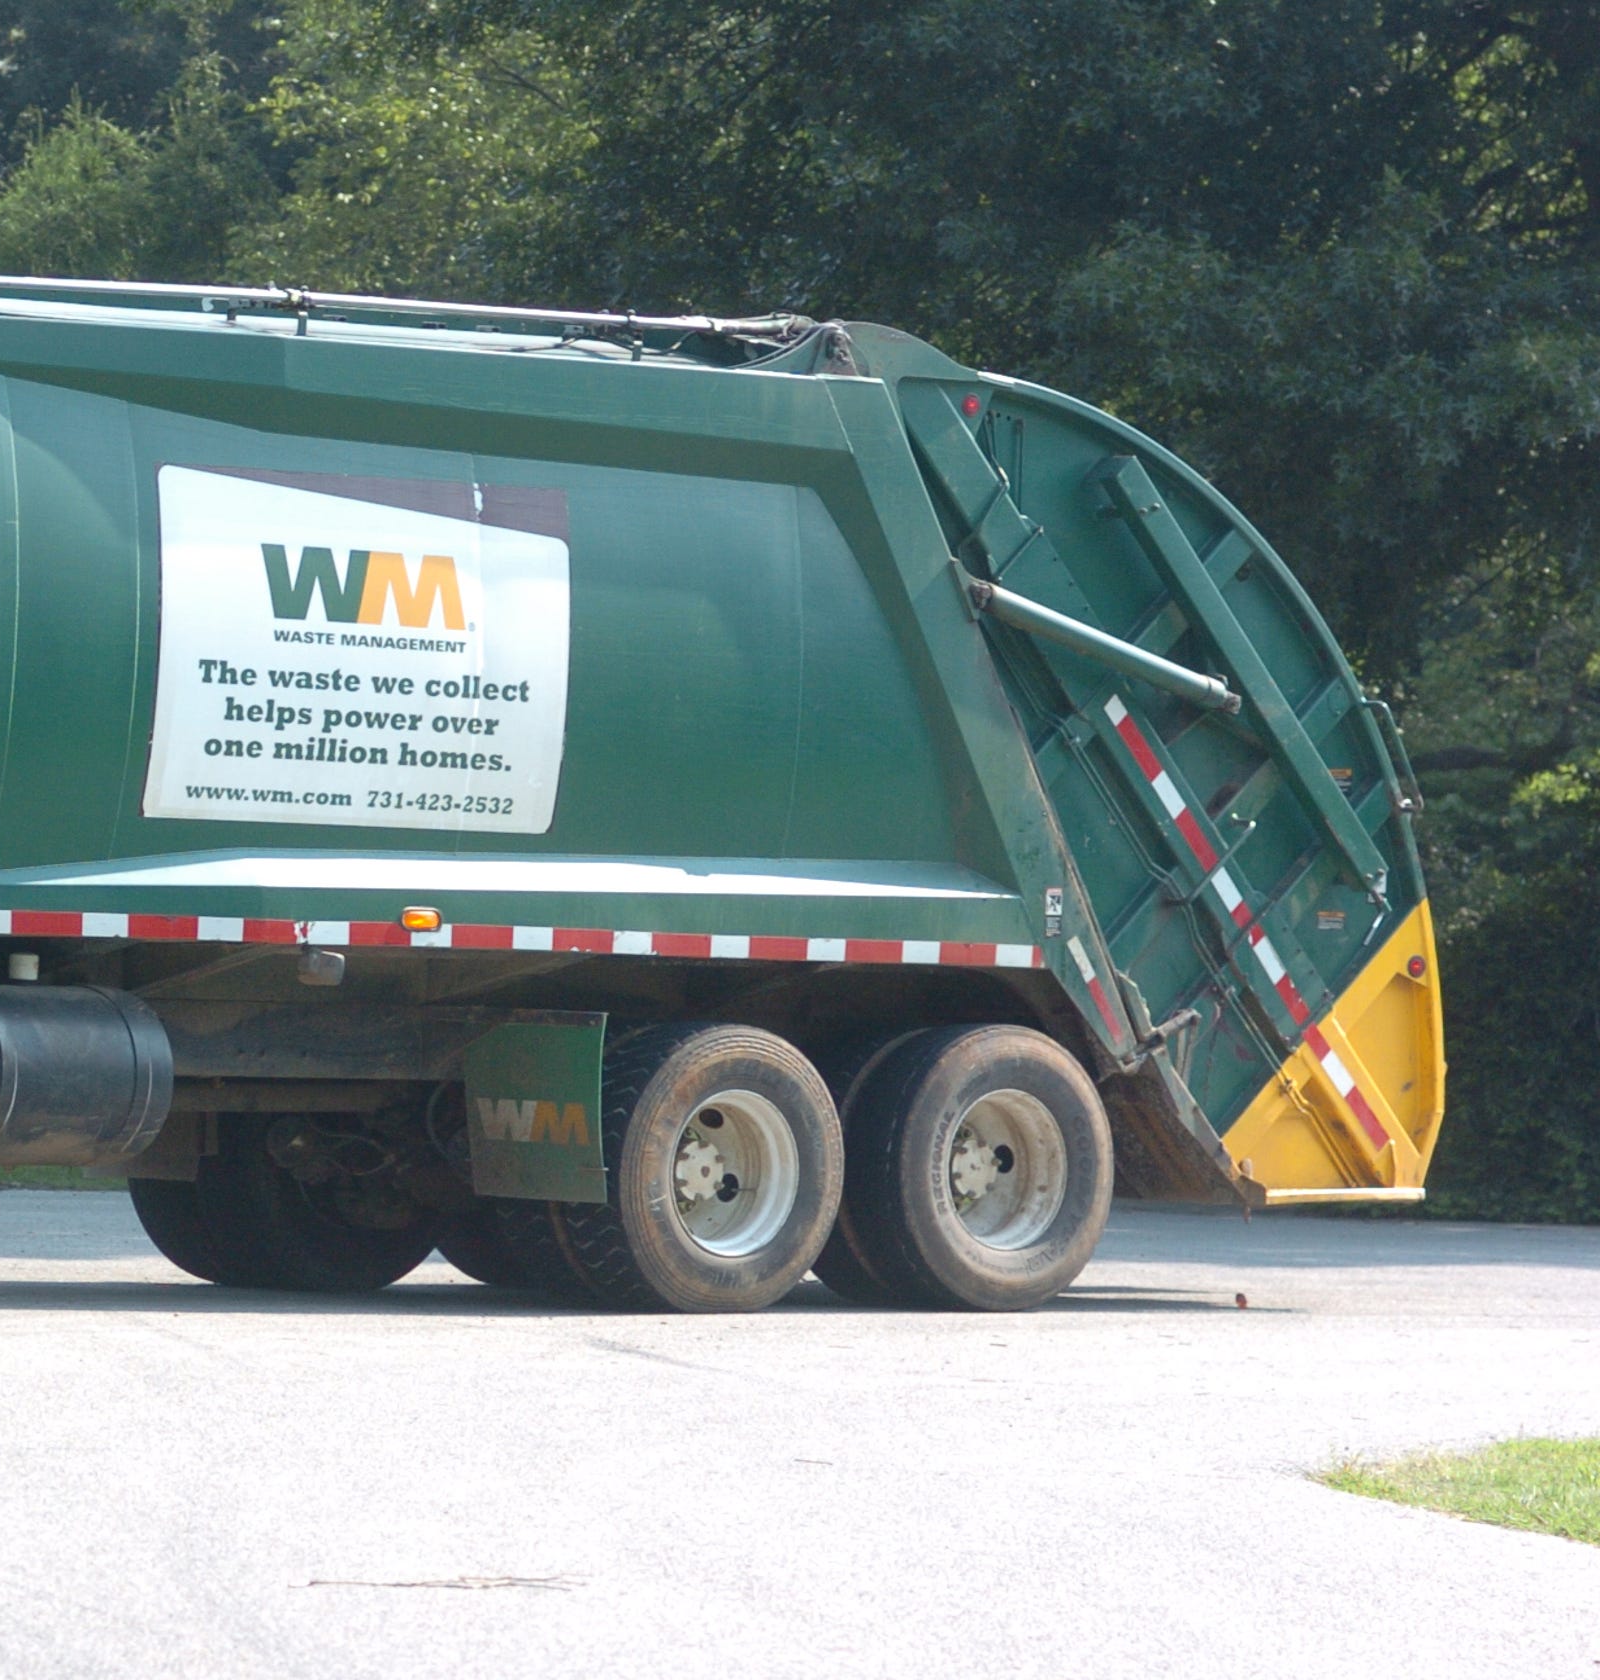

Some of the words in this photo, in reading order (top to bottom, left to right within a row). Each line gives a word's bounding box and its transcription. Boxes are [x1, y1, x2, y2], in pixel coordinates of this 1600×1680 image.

[261, 543, 467, 630] WM
[273, 630, 335, 647] WASTE
[341, 633, 467, 654] MANAGEMENT
[199, 658, 258, 686] The
[268, 668, 361, 693] waste
[371, 675, 414, 696] we
[424, 677, 530, 703] collect
[224, 697, 313, 727] helps
[322, 707, 423, 733] power
[432, 715, 500, 736] over
[204, 738, 263, 759] one
[273, 737, 390, 766] million
[398, 743, 513, 772] homes.
[185, 784, 353, 807] www.wm.com
[366, 790, 514, 815] 731-423-2532
[477, 1099, 589, 1146] WM
